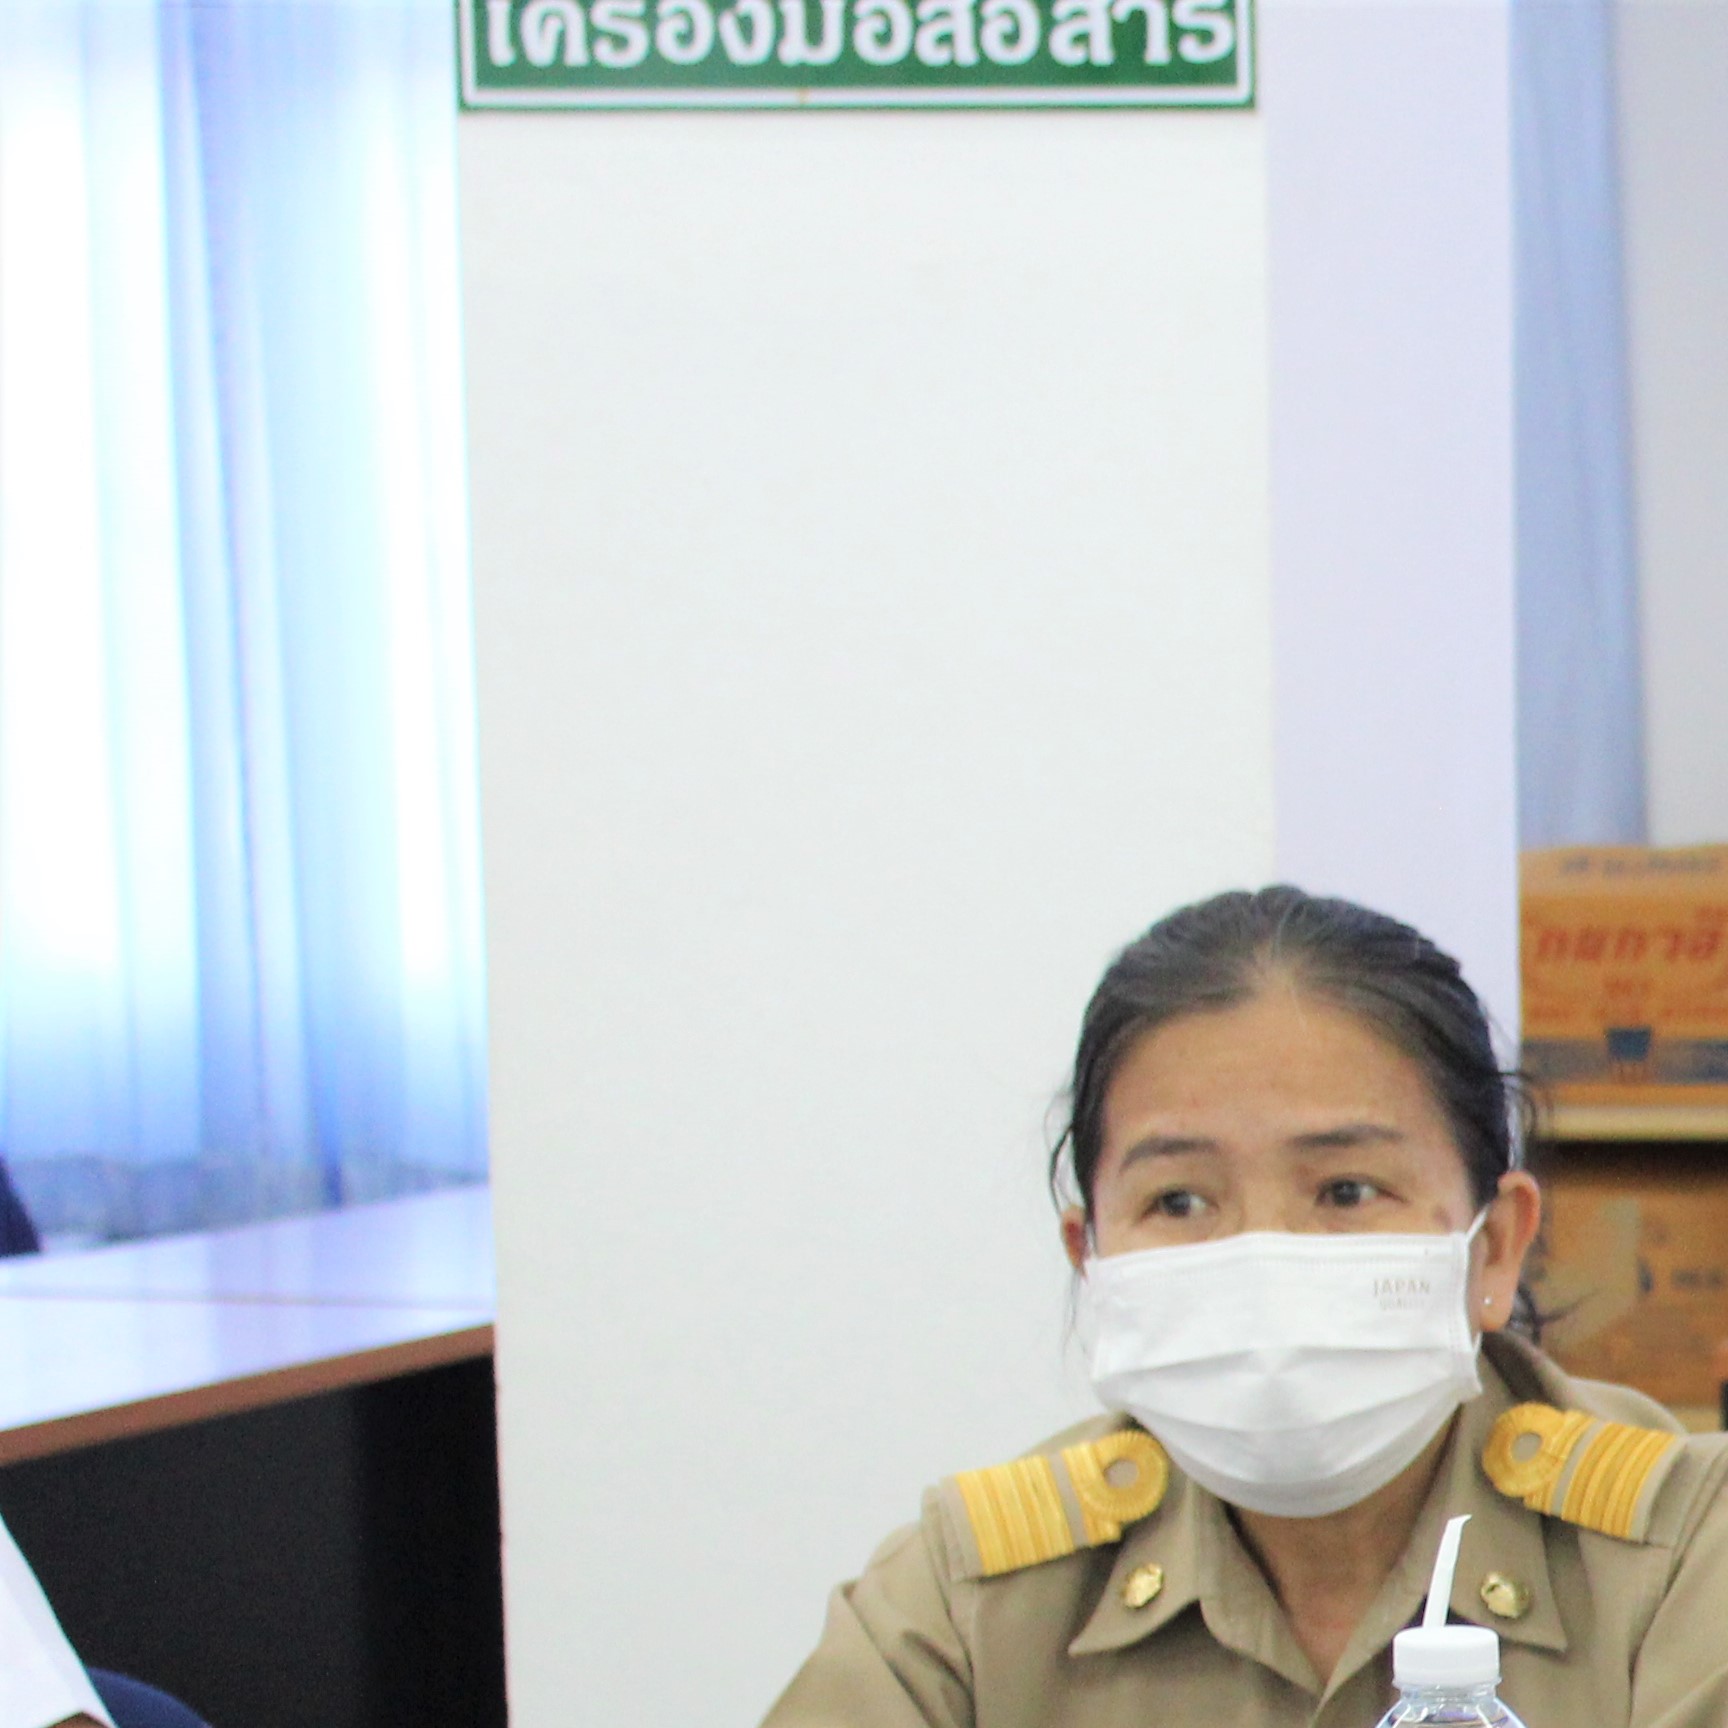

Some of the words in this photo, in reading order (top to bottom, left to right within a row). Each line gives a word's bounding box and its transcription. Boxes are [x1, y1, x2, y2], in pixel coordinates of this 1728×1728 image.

[487, 0, 1234, 67] เครองมอสอสาร
